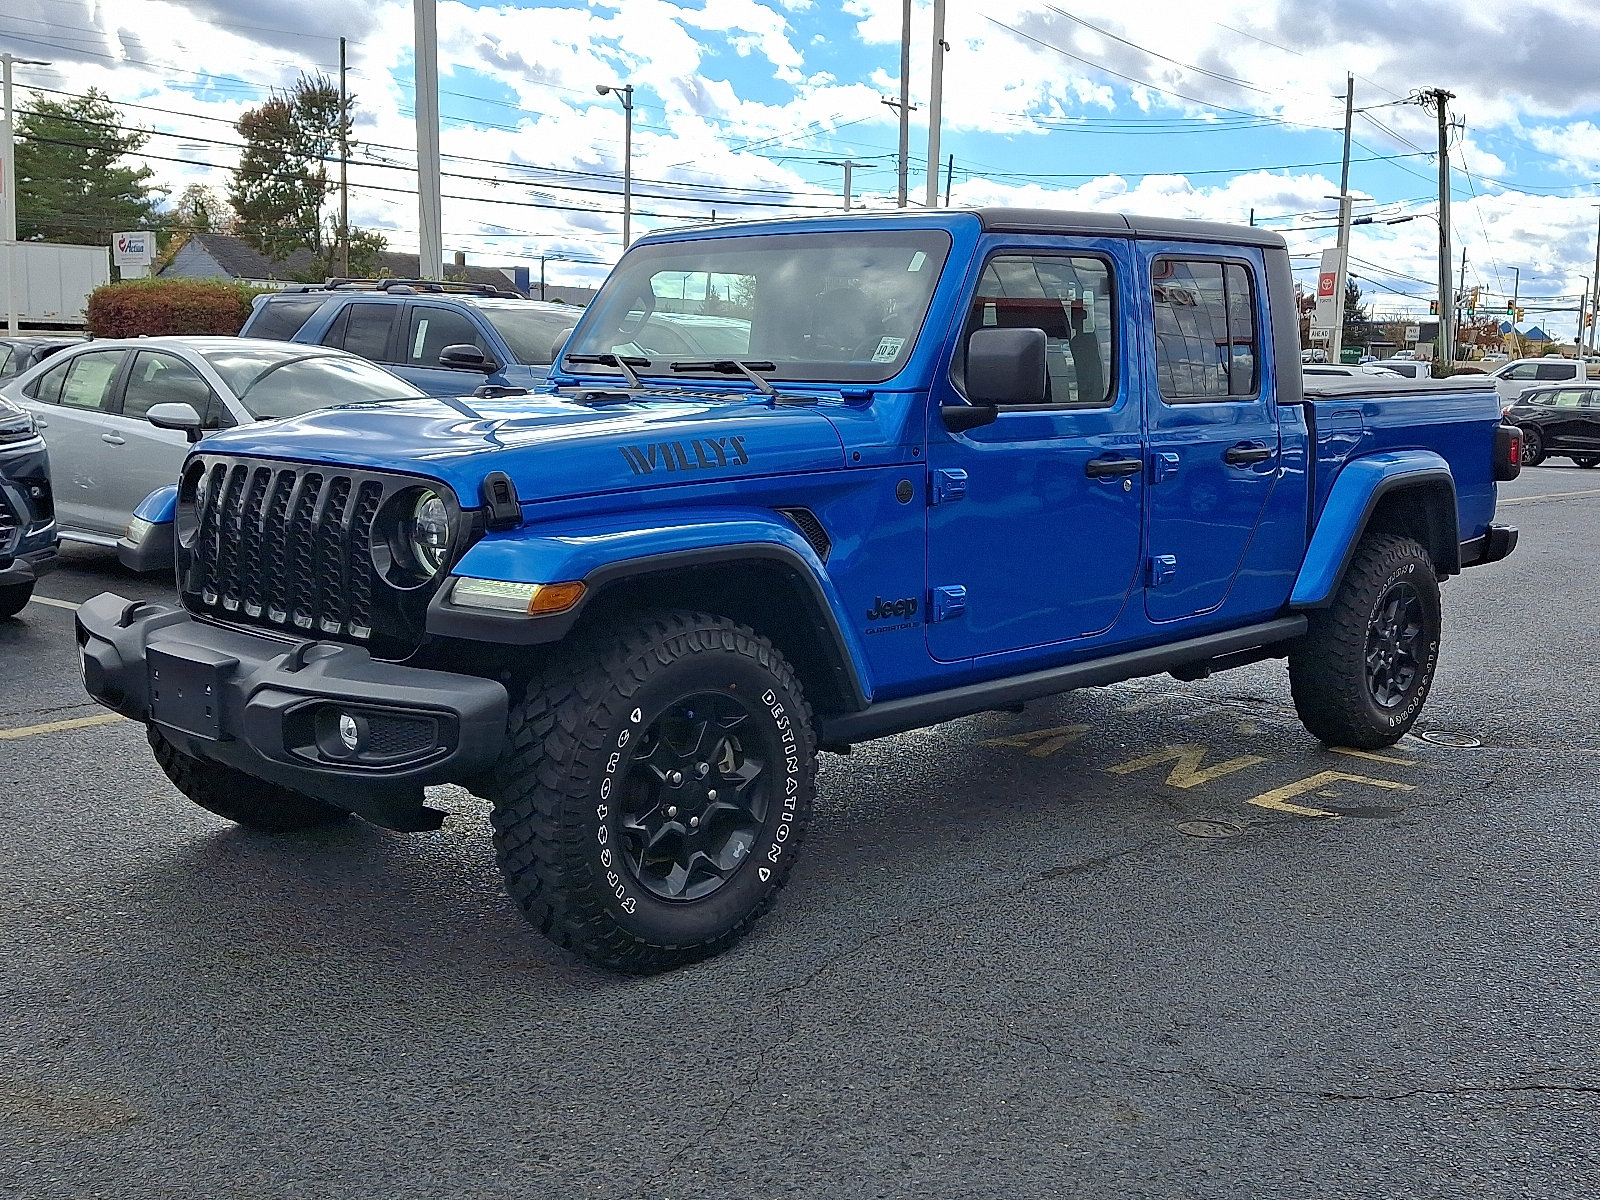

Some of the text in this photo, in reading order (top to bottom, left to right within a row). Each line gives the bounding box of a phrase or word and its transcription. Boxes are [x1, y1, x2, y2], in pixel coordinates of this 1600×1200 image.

[125, 240, 144, 252] Action
[876, 345, 888, 355] 10
[618, 435, 749, 475] WILLYS
[866, 596, 919, 621] Jeep
[865, 622, 913, 635] GLADIATOR
[762, 689, 798, 863] DESTINATION
[978, 723, 1418, 819] ANE
